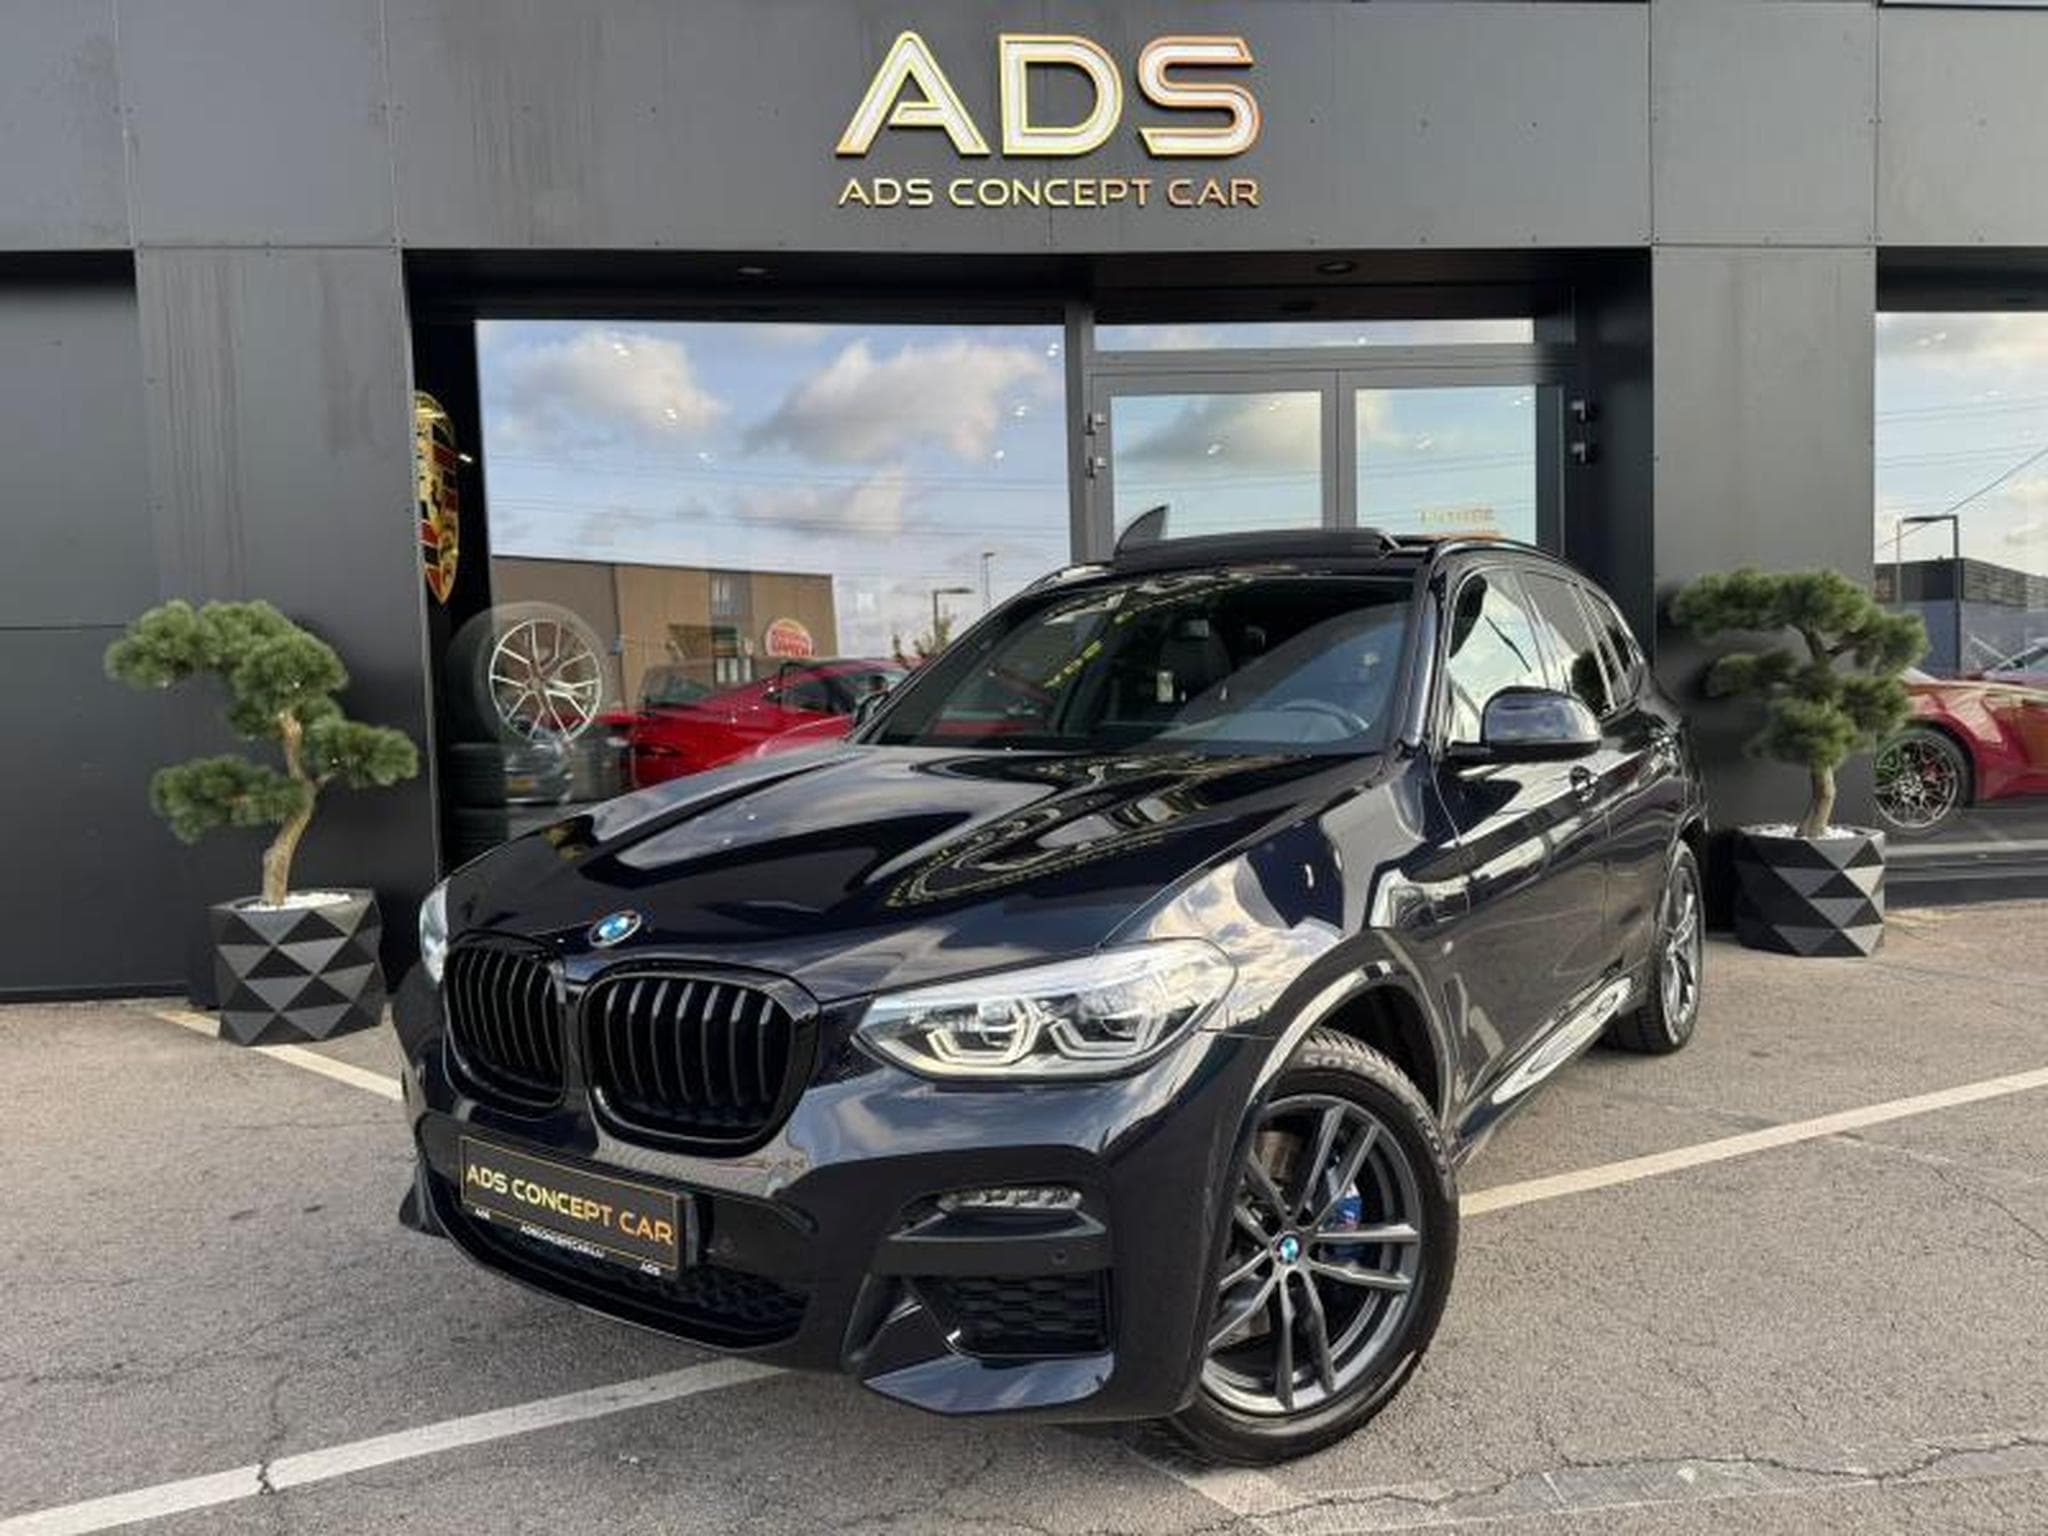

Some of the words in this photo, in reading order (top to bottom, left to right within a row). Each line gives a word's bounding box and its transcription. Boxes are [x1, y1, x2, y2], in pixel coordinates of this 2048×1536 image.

[835, 30, 1261, 156] ADS
[838, 178, 933, 207] ADS
[948, 178, 1152, 207] CONCEPT
[1168, 178, 1260, 207] CAR
[466, 1164, 508, 1195] ADS
[511, 1179, 613, 1227] CONCEPT
[619, 1210, 674, 1246] CAR
